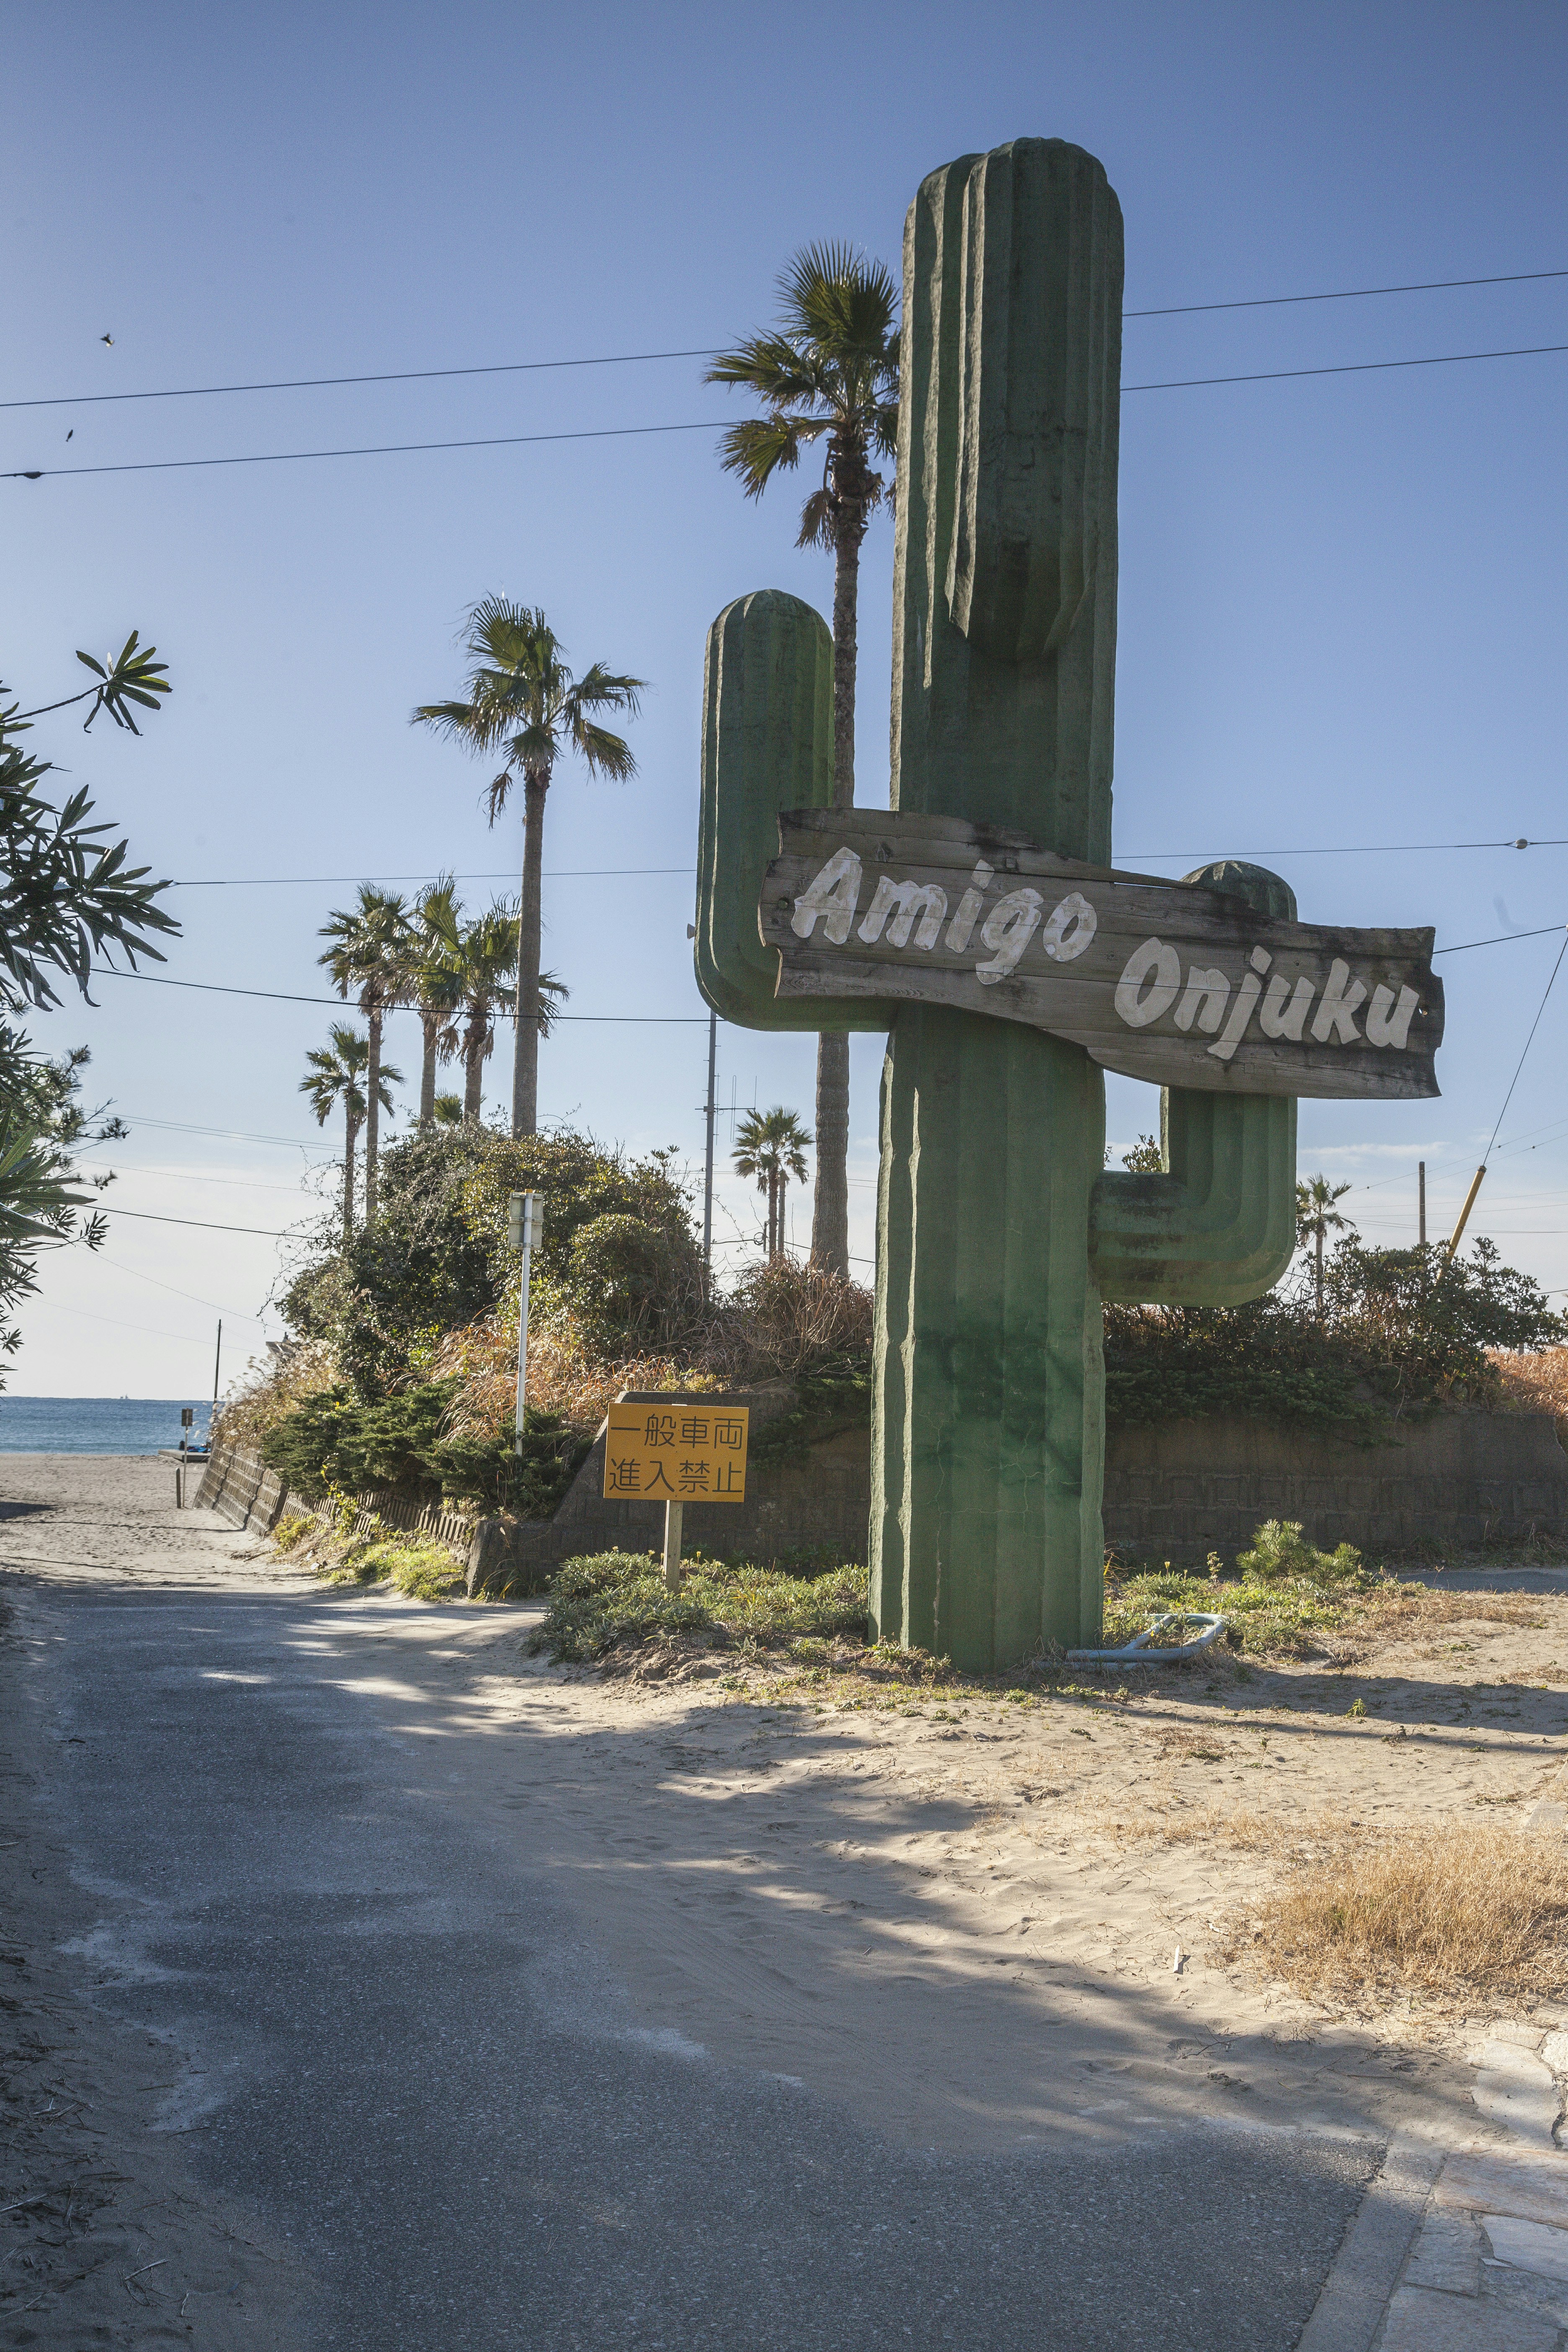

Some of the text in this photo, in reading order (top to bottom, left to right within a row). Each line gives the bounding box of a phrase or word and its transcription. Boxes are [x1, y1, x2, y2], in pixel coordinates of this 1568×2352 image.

[790, 846, 1097, 985] Amigo
[1114, 936, 1419, 1060] Onjuku
[611, 1413, 745, 1450] 一般車両
[609, 1458, 743, 1493] 進入禁止
